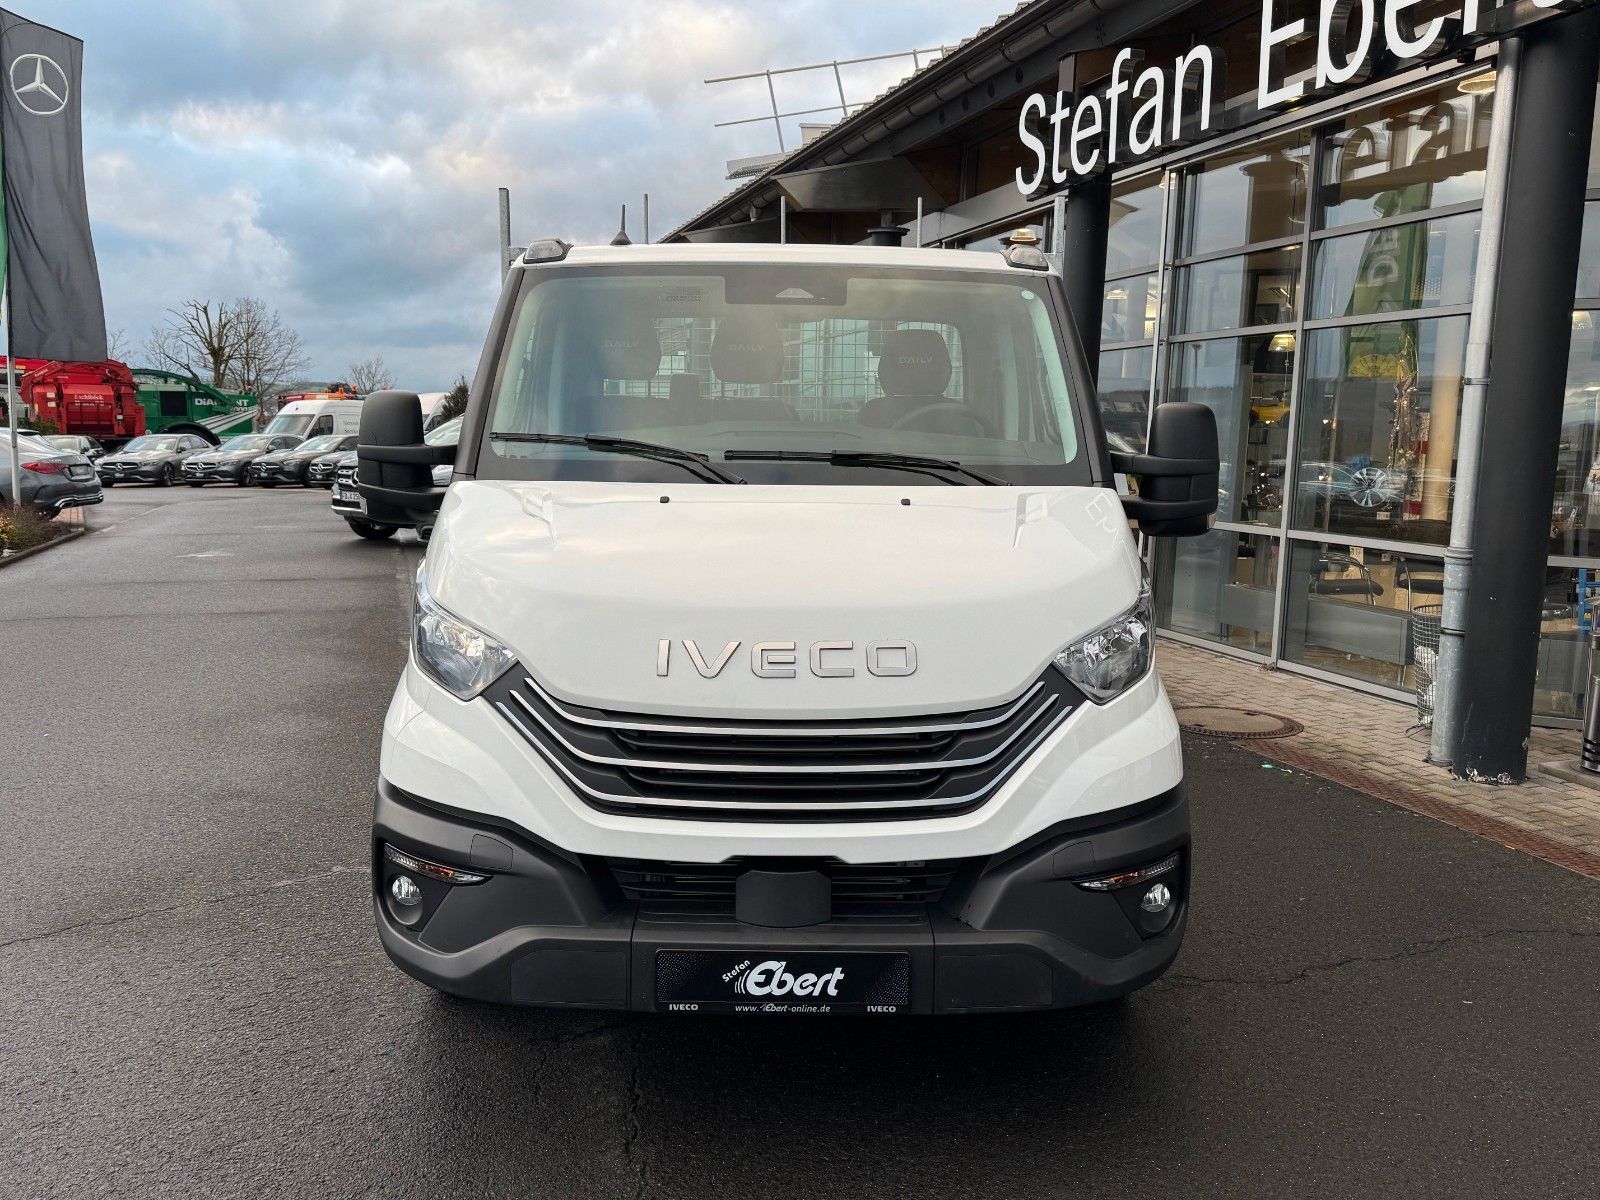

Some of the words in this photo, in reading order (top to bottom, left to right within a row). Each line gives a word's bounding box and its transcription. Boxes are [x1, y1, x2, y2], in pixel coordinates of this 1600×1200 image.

[1016, 45, 1213, 195] Stefan
[899, 356, 933, 364] DAILY
[657, 639, 918, 679] IVECO
[722, 960, 751, 982] Stefan
[746, 960, 845, 996] Ebert
[669, 1003, 699, 1011] IVECO
[735, 1003, 831, 1013] www.Ebert-online.de
[867, 1005, 897, 1013] IVECO
